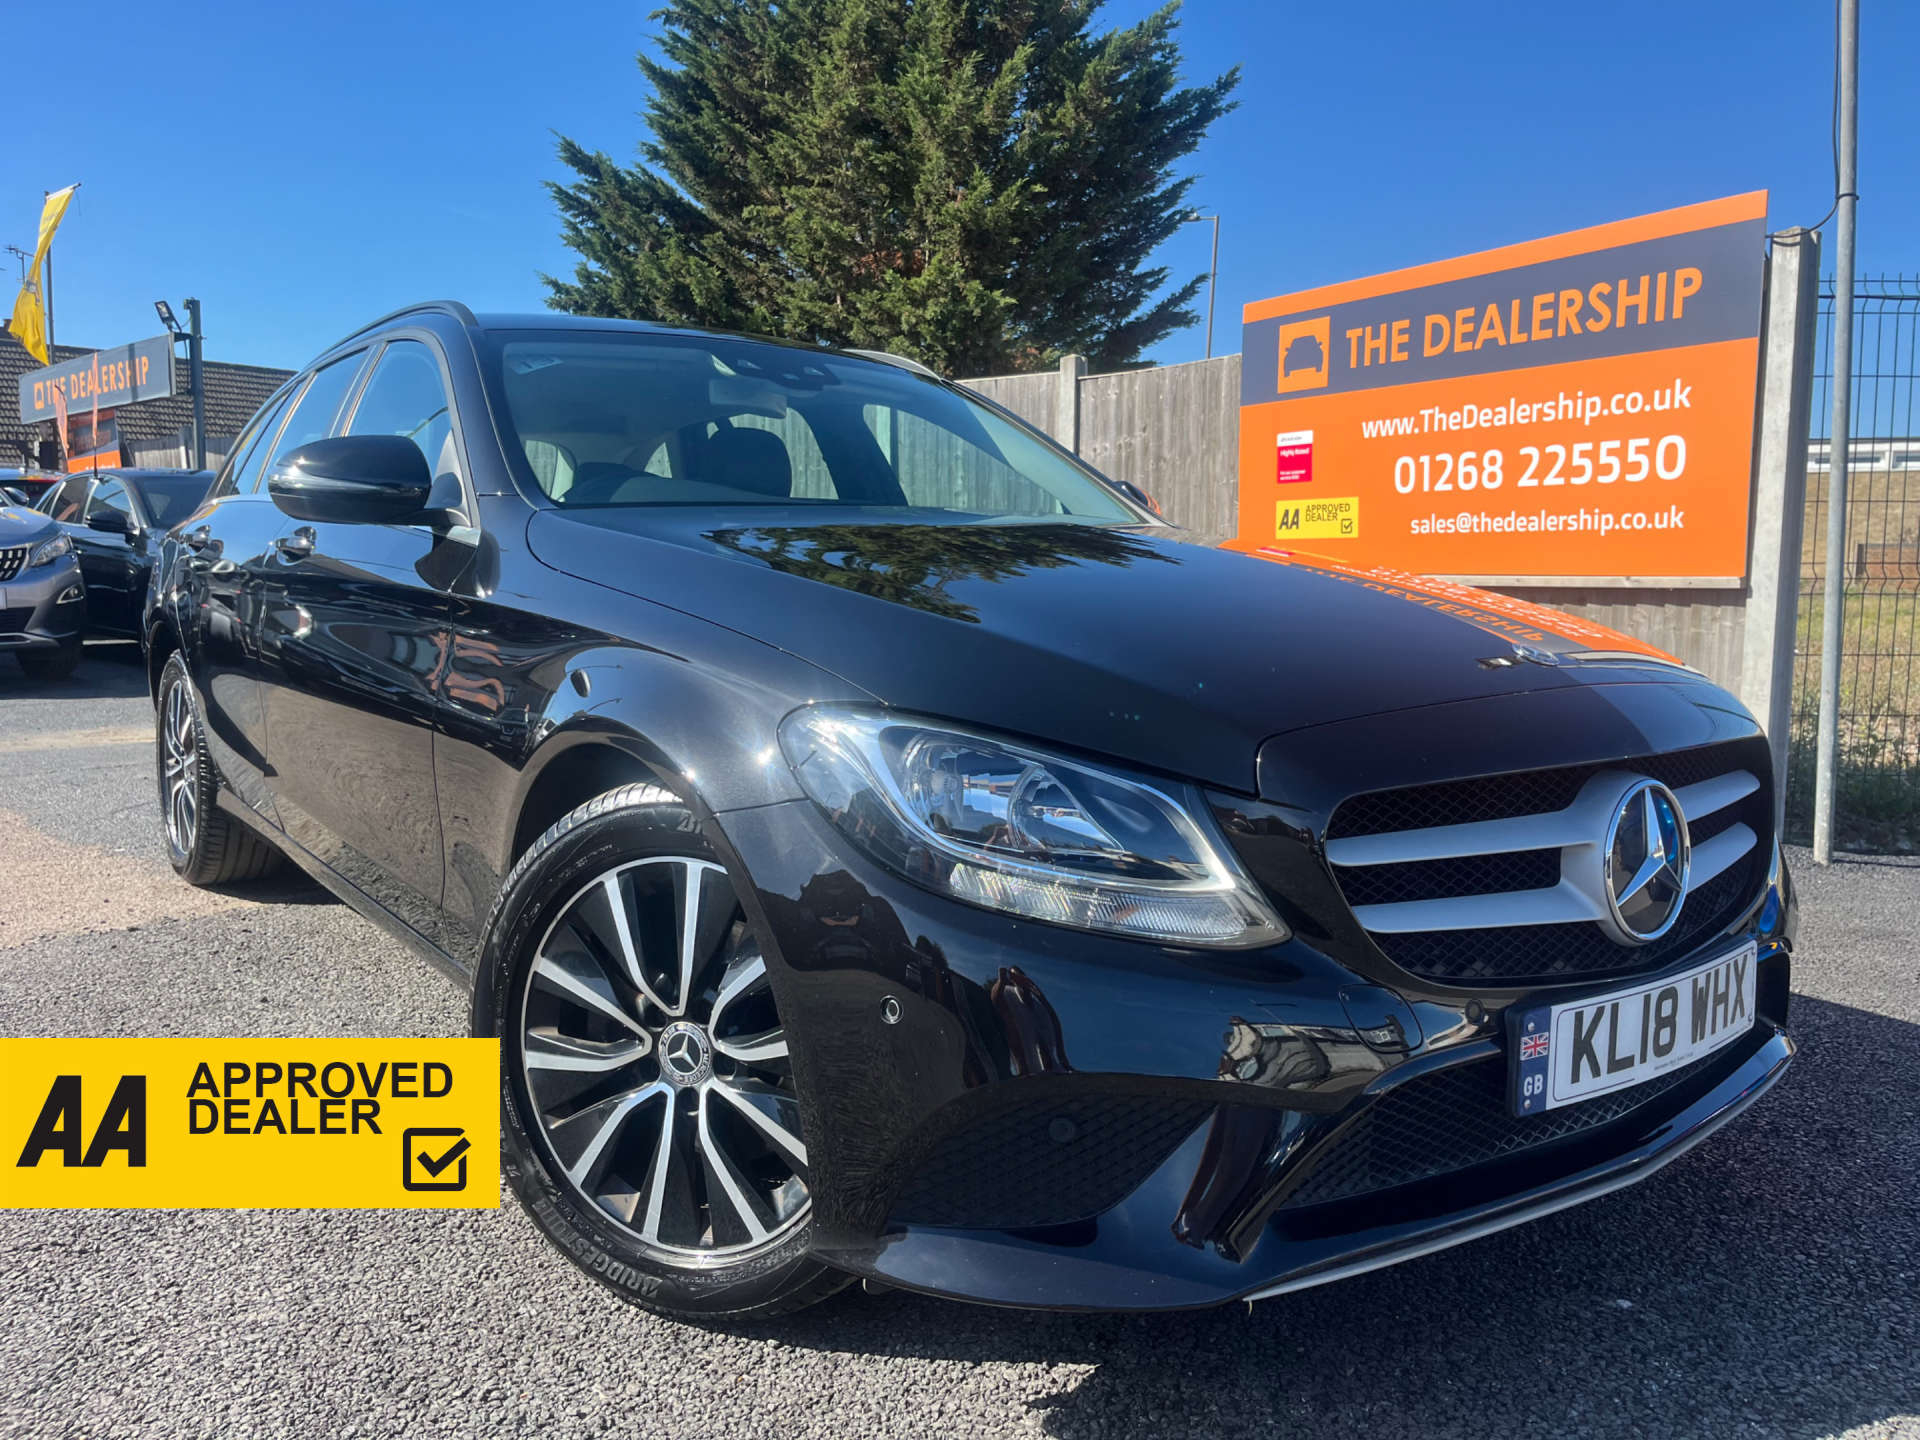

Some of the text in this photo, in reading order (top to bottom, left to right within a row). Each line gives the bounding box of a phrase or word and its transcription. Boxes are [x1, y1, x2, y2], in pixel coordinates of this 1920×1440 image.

[1346, 267, 1703, 368] THE DEALERSHIP
[1362, 378, 1692, 440] www.TheDealership.co.uk
[1395, 435, 1686, 494] 01268 225550
[1279, 508, 1299, 530] AA
[1305, 503, 1350, 513] APPROVED
[1305, 512, 1338, 522] DEALER
[1411, 505, 1684, 536] sales@thedealership.co.uk
[1571, 955, 1748, 1085] KL18 WHX
[1523, 1073, 1543, 1097] GB
